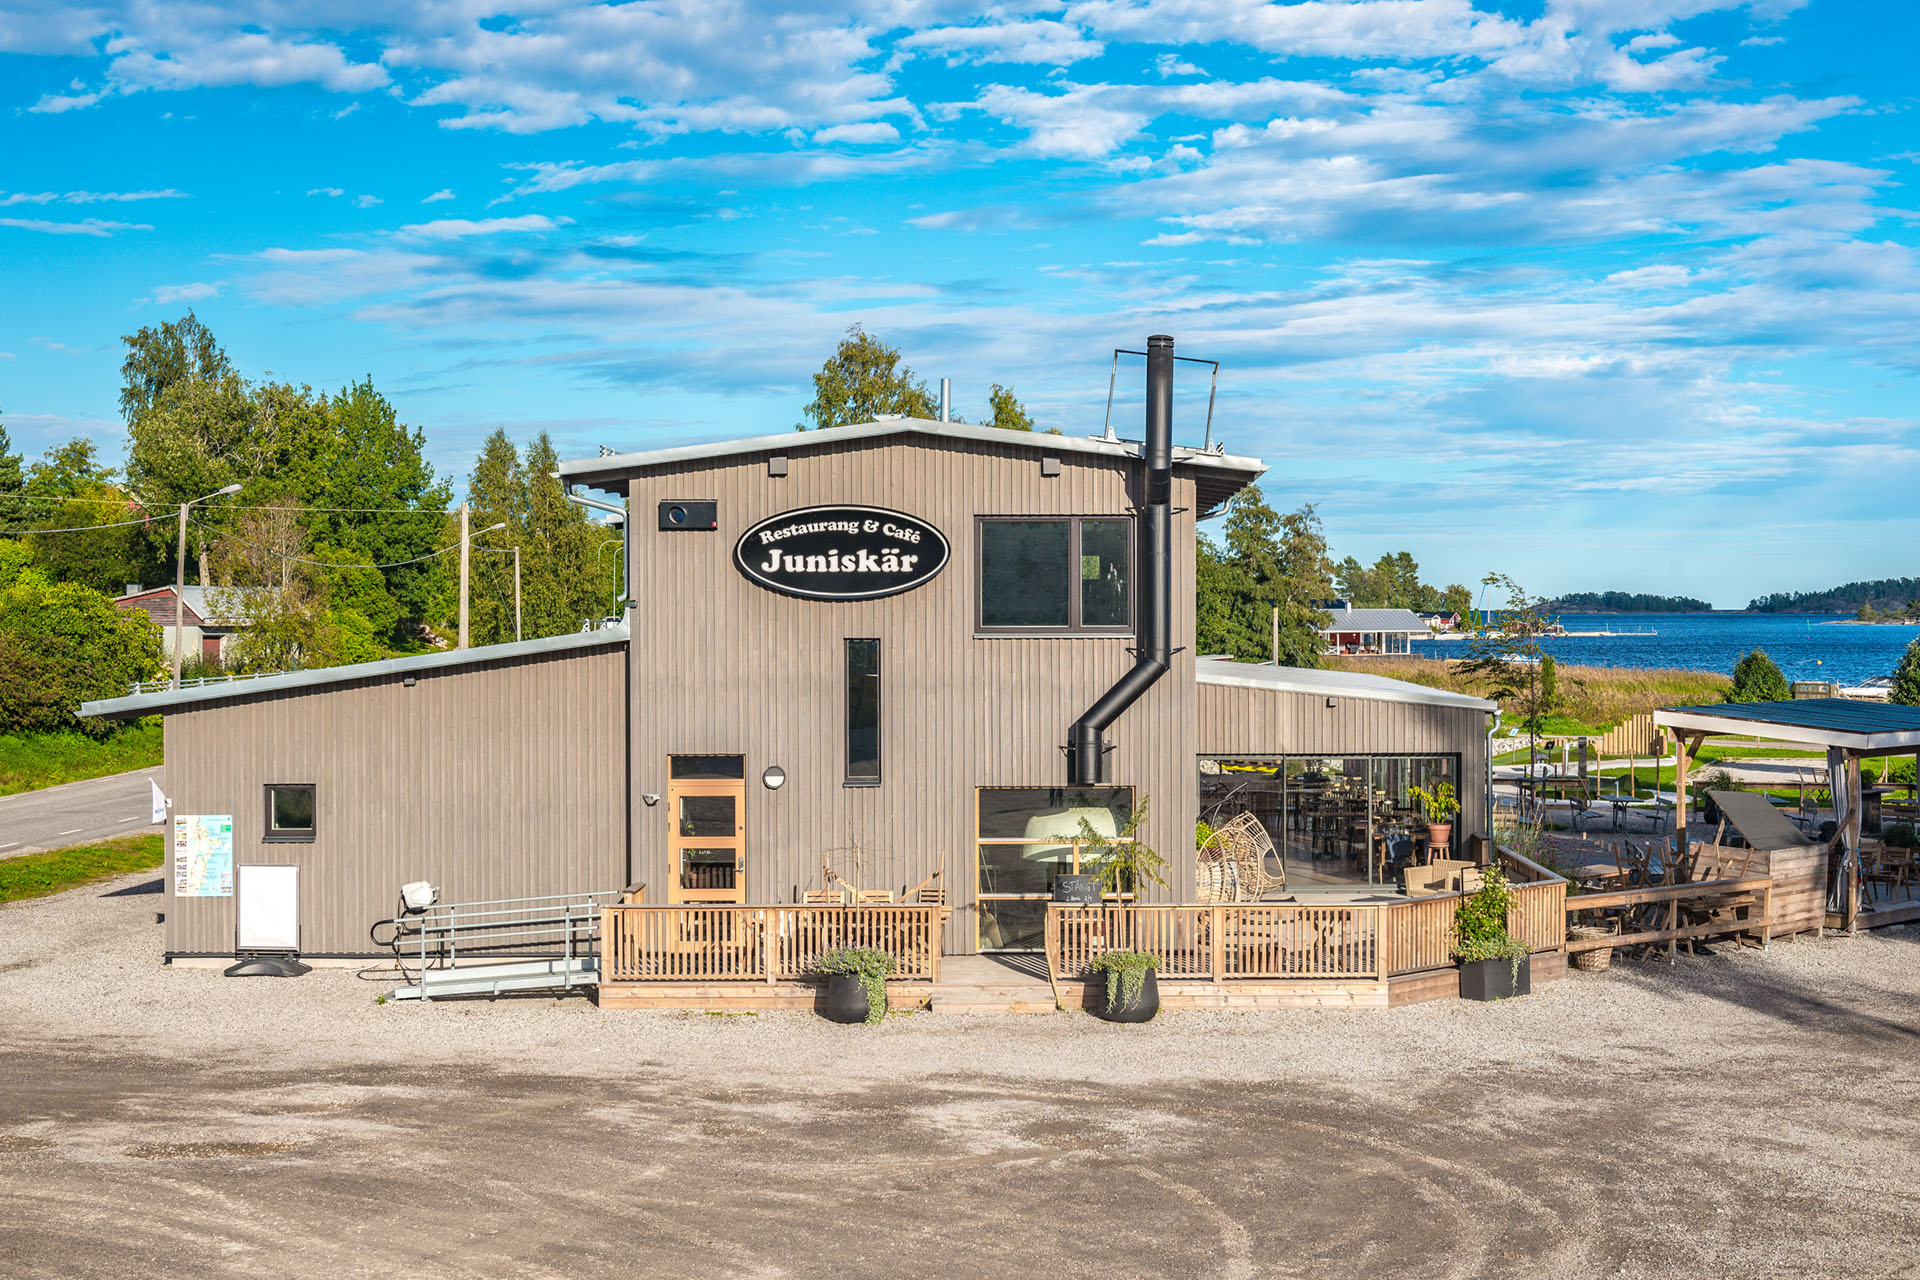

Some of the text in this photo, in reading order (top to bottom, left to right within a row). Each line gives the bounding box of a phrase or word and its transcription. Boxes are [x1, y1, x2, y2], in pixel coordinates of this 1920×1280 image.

[759, 520, 921, 544] Restaurang & Café
[761, 549, 918, 572] Juniskär
